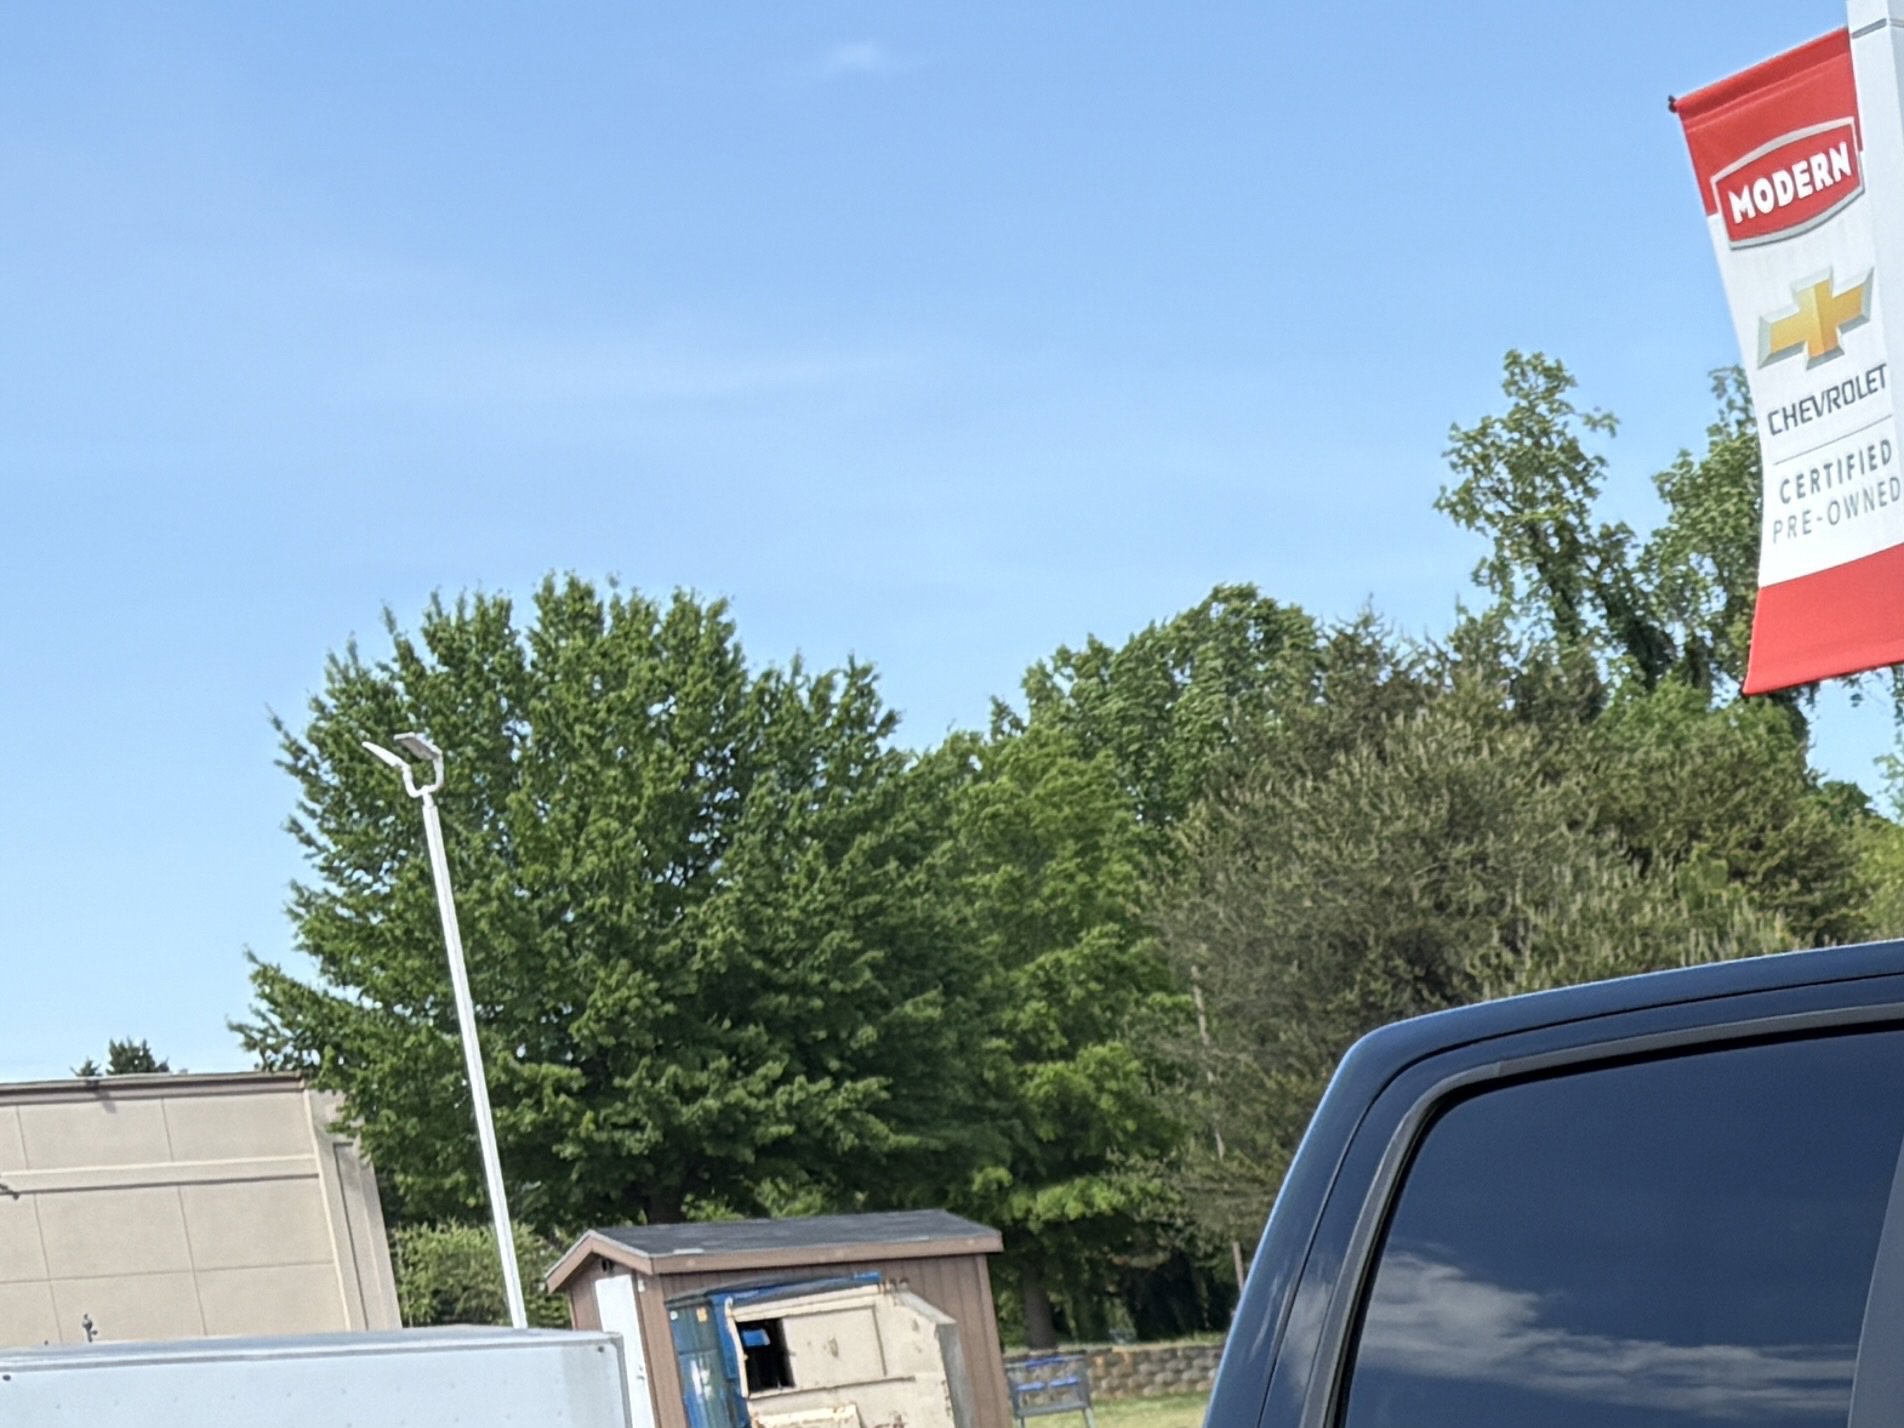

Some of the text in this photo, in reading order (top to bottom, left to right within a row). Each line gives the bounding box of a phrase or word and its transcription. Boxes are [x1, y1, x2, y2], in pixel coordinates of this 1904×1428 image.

[1728, 141, 1852, 224] MODERN
[1767, 363, 1887, 436] CHEVROLET
[1779, 439, 1892, 504] CERTIFIED
[1773, 476, 1901, 544] PRE-OWNED
